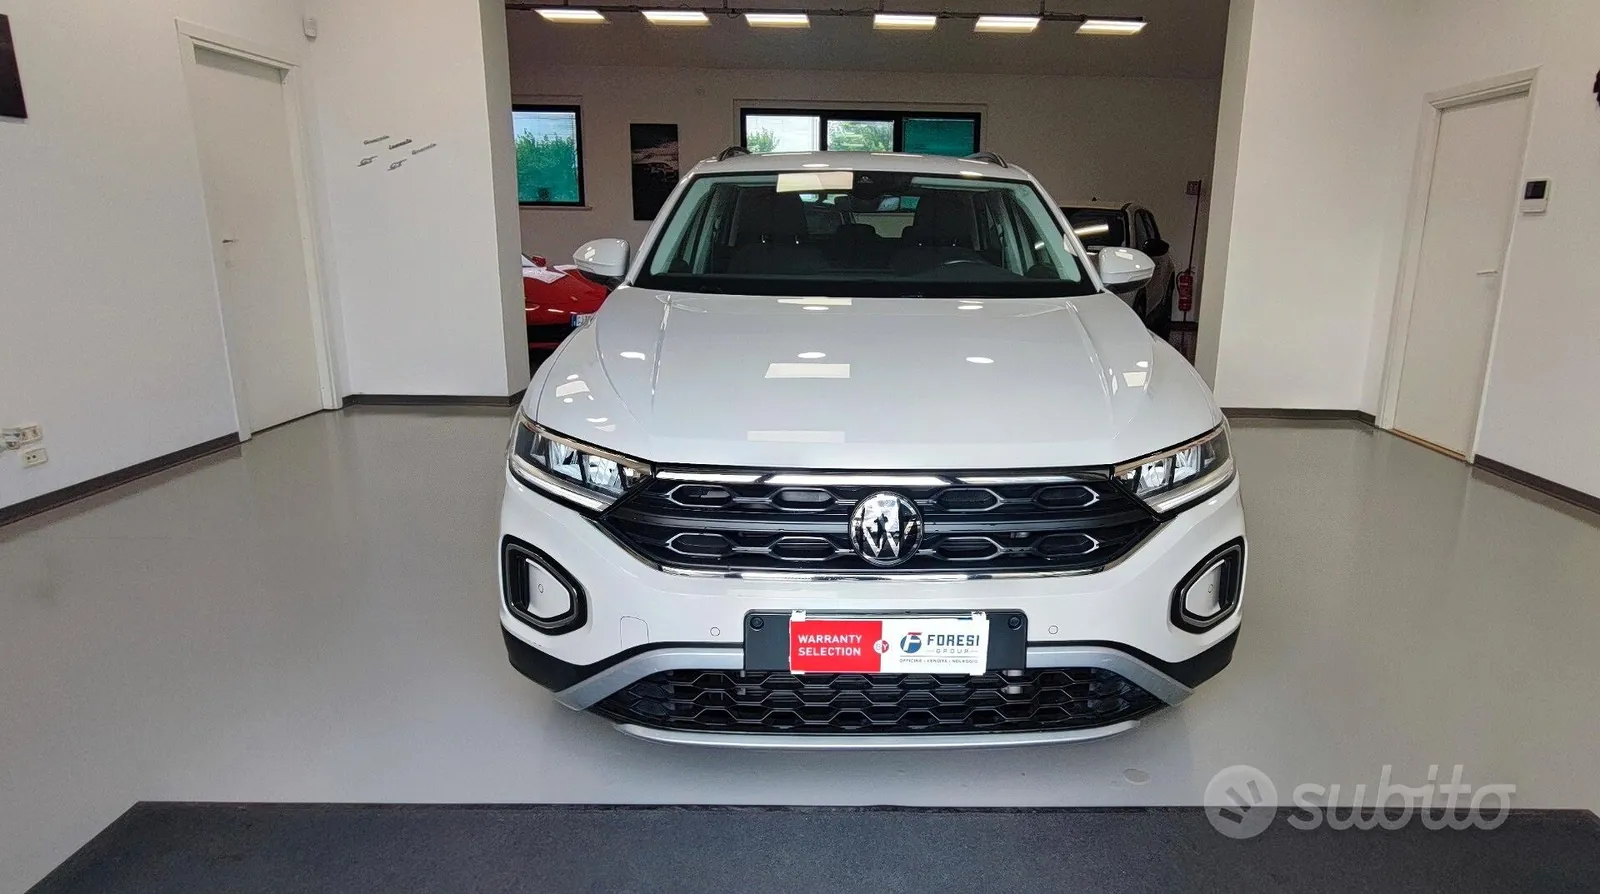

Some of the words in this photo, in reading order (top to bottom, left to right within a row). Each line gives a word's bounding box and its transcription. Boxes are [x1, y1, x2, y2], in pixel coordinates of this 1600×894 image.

[797, 634, 862, 644] WARRANTY
[927, 634, 980, 647] FORESI
[798, 647, 862, 656] SELECTION
